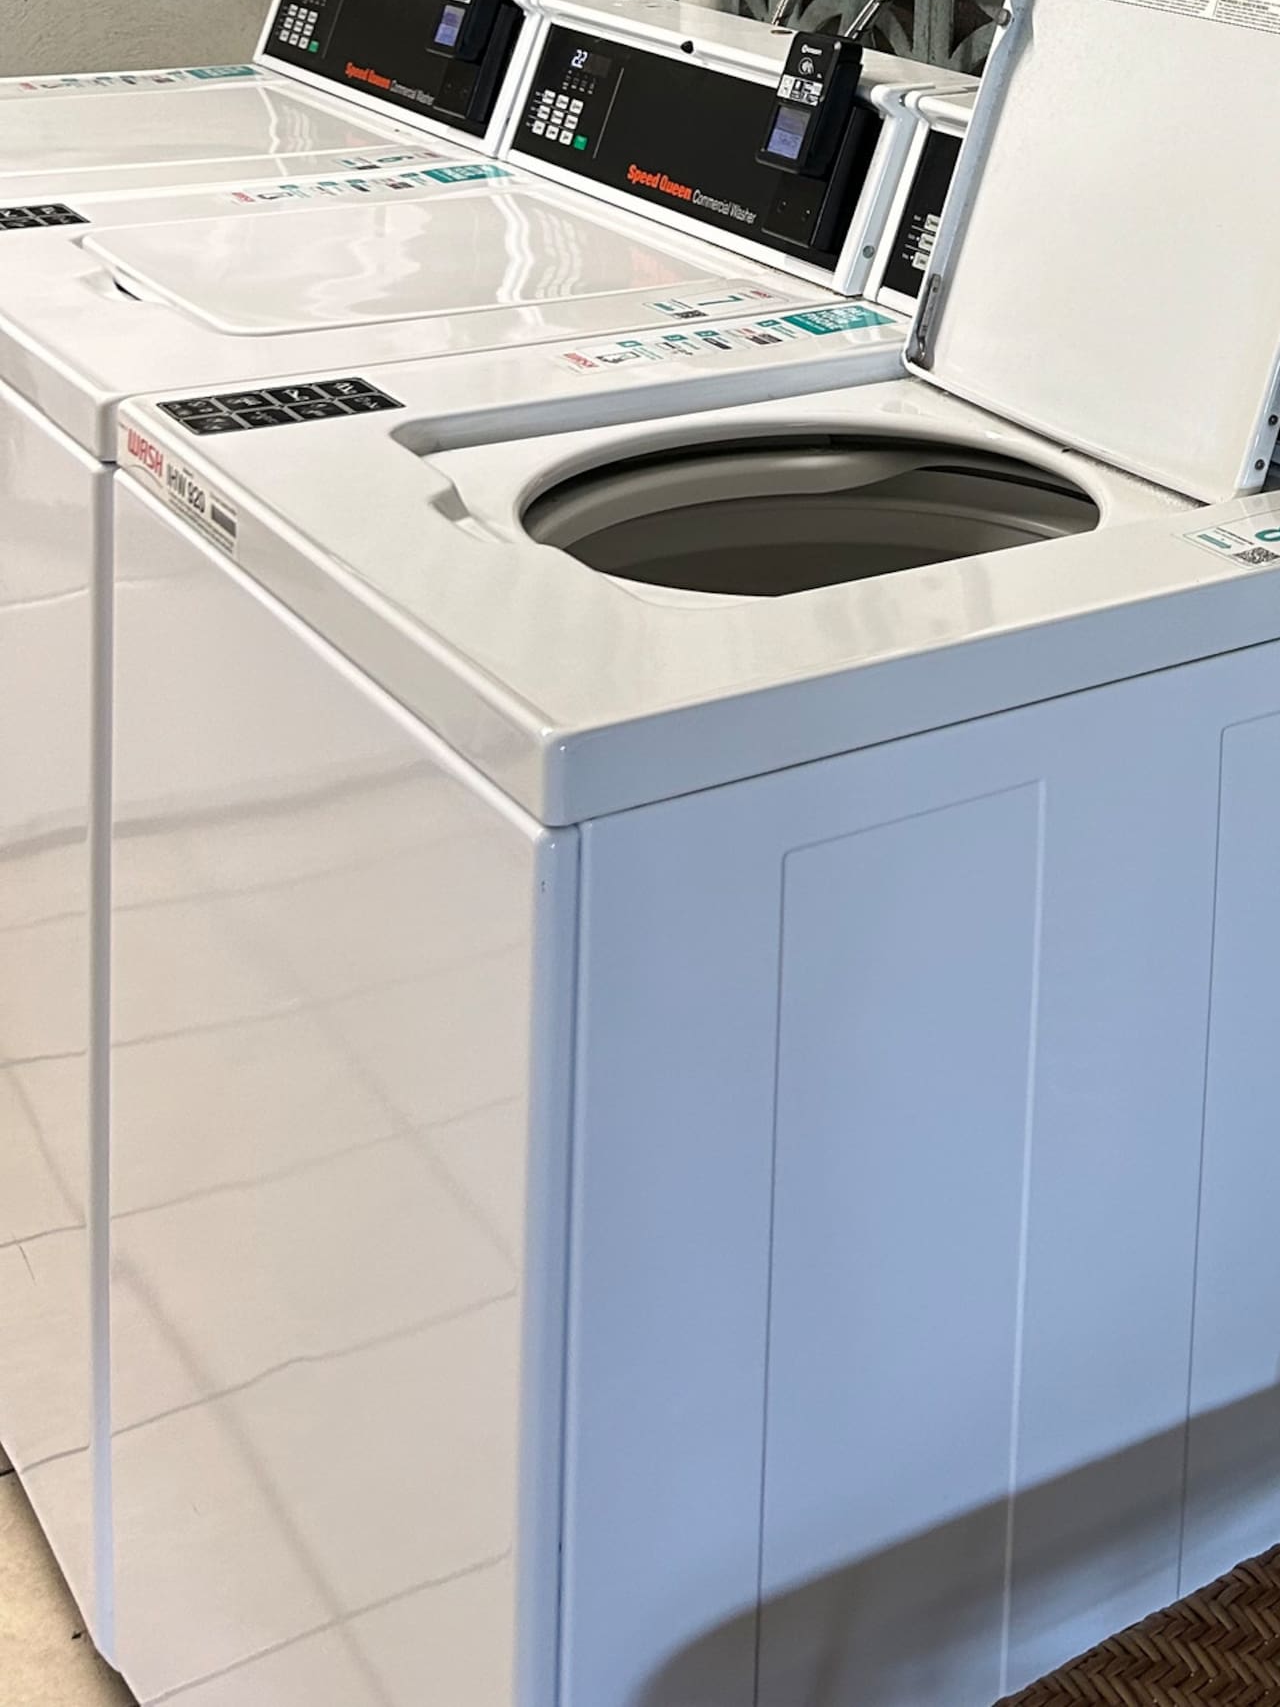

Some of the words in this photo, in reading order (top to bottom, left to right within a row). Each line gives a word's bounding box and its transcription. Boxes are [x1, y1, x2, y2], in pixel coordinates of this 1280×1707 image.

[571, 48, 588, 69] 22
[627, 164, 661, 188] Speed
[660, 175, 693, 201] Queen
[692, 189, 732, 216] Commercial
[127, 428, 164, 477] WASH
